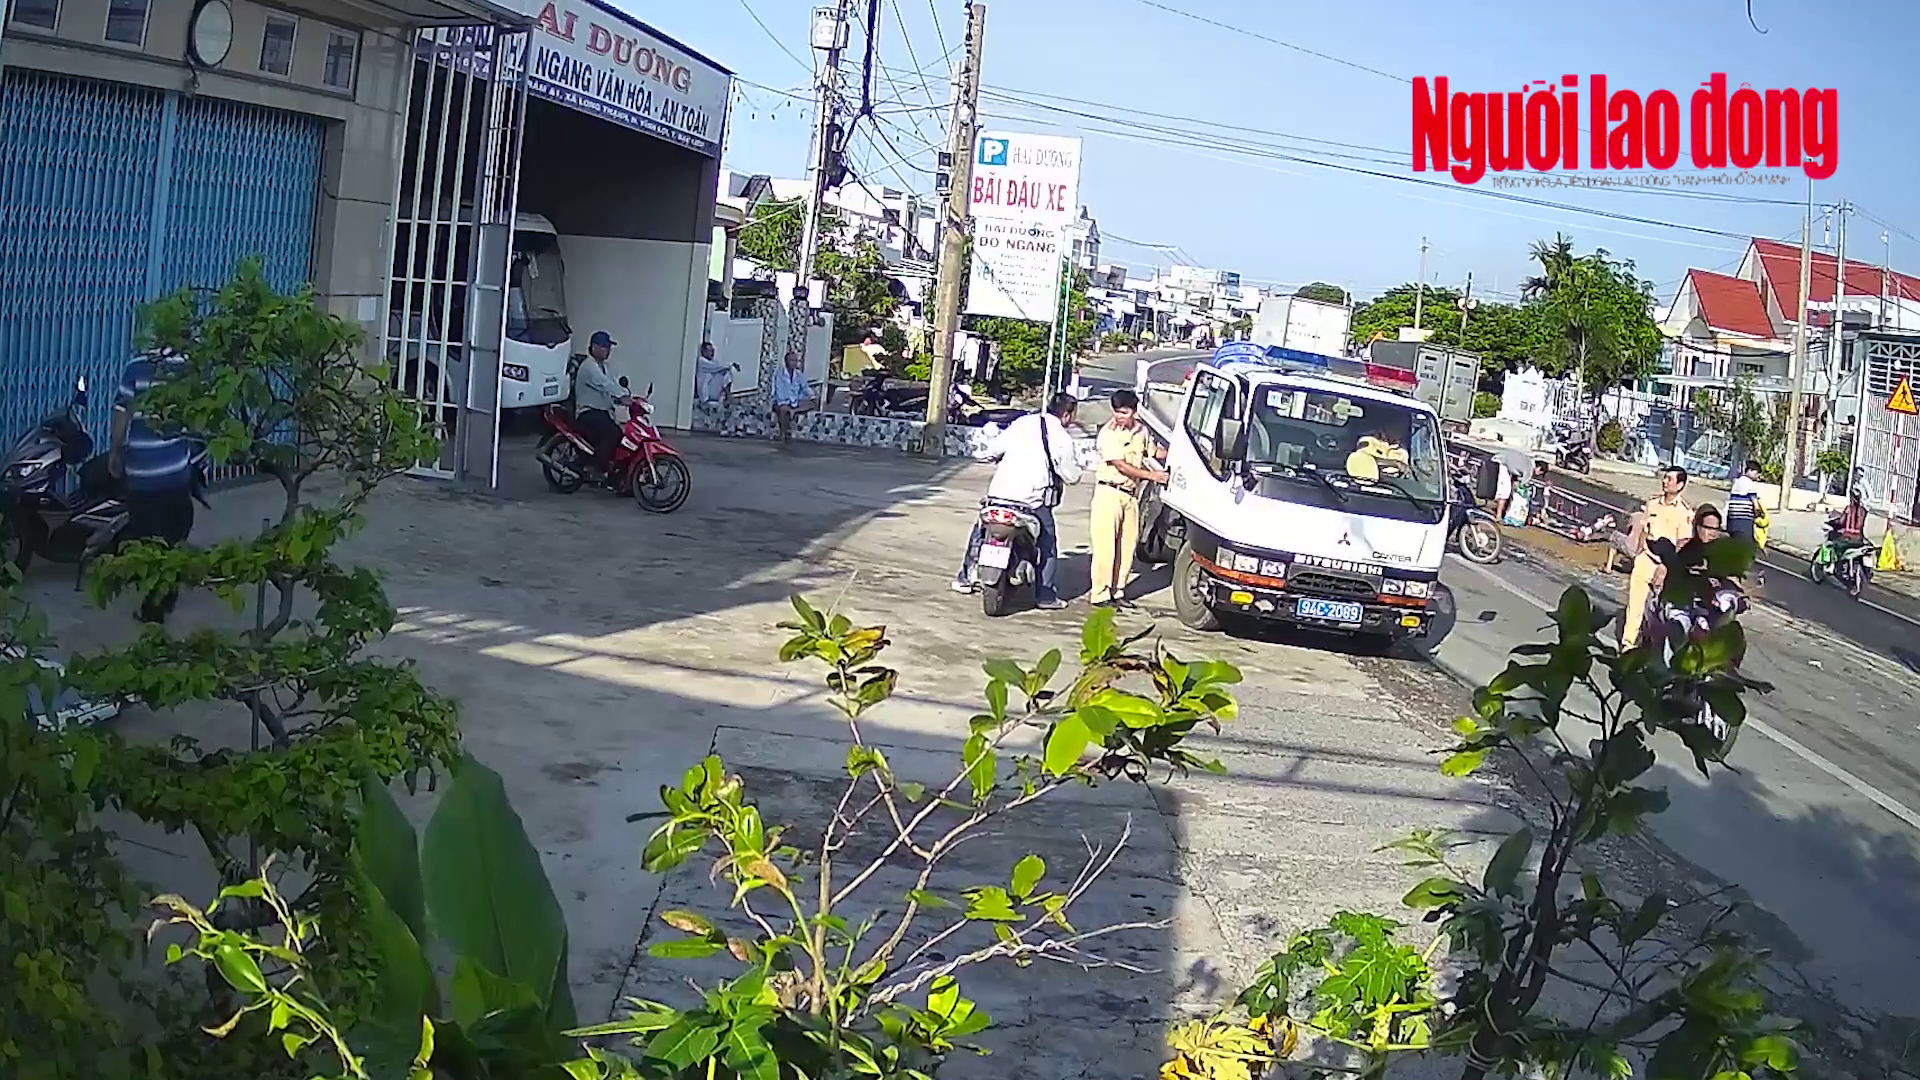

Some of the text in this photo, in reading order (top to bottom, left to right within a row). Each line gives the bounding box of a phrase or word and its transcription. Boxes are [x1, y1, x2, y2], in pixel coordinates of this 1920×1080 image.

[586, 22, 692, 94] DƯƠNG
[535, 46, 592, 92] NGANG
[597, 68, 625, 105] VĂN
[626, 80, 652, 116] HÓA
[660, 98, 679, 125] AN
[681, 105, 709, 136] TOÀN
[983, 140, 1005, 164] P
[973, 171, 1002, 206] BÃI
[1045, 183, 1067, 211] XE
[1006, 239, 1056, 253] NGANG
[1372, 551, 1412, 562] CANTER
